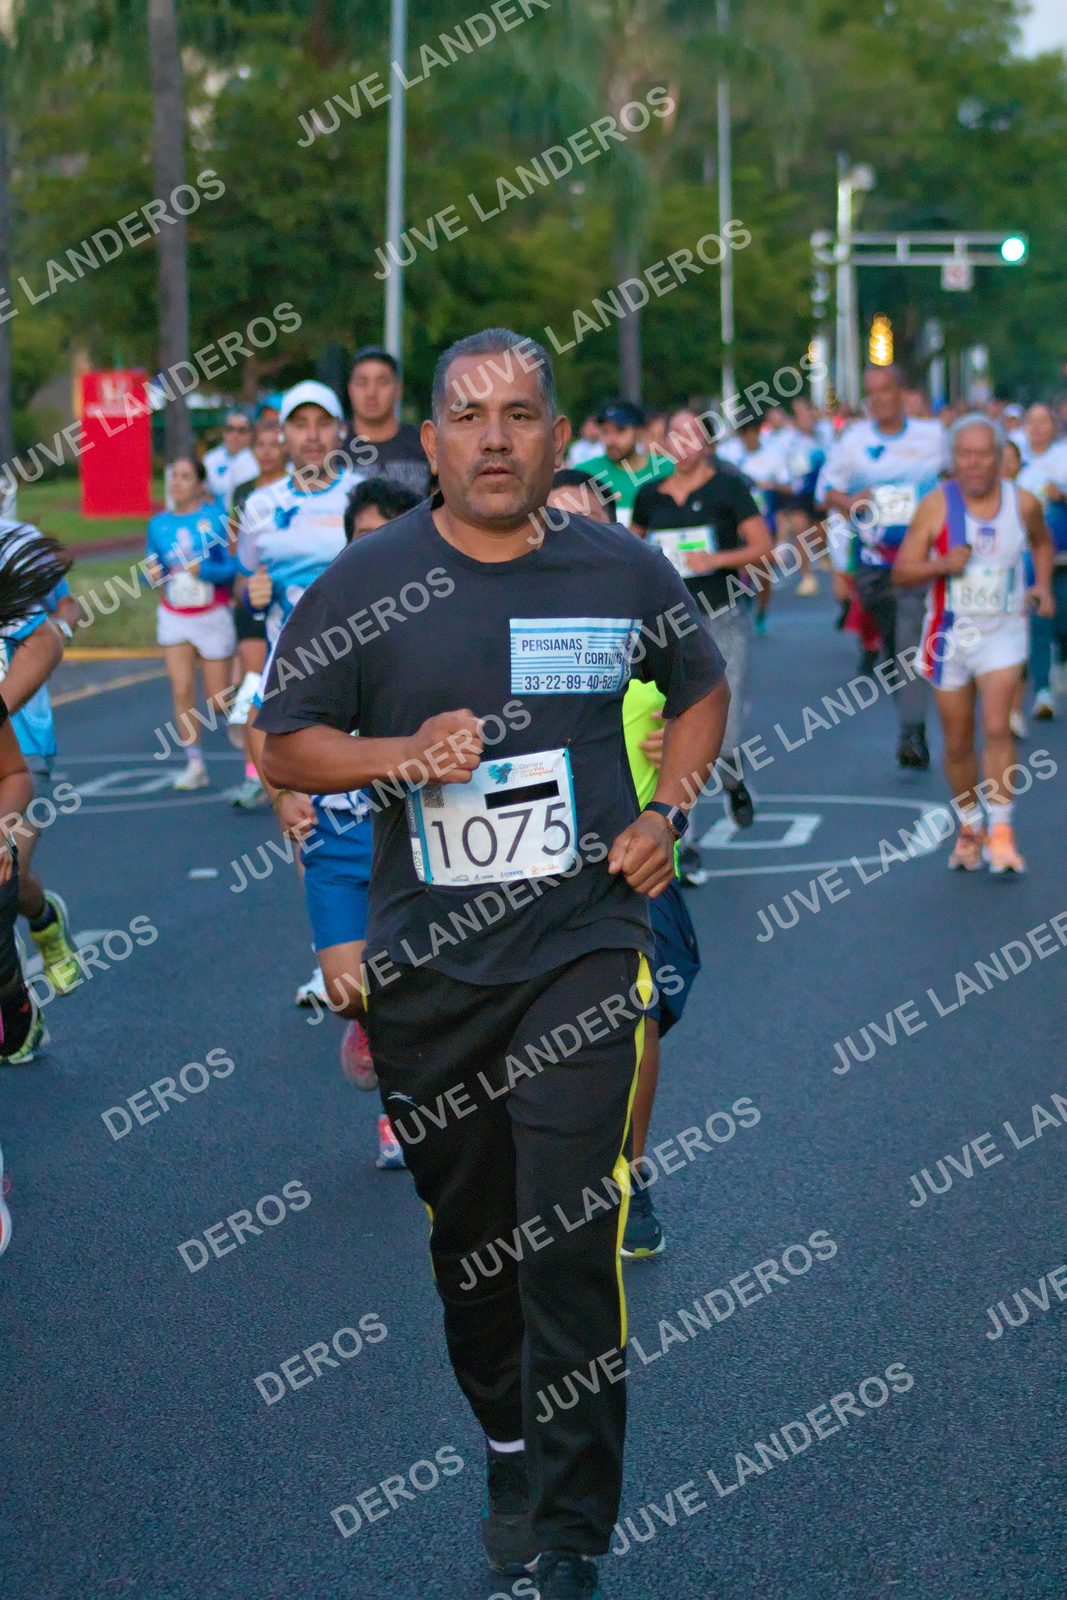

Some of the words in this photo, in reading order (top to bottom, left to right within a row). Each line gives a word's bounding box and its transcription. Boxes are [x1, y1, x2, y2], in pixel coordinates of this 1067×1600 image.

[522, 638, 583, 652] PERSIANAS
[574, 652, 582, 664] Y
[524, 674, 613, 690] 33-22-89-40-52
[431, 801, 571, 869] 1075
